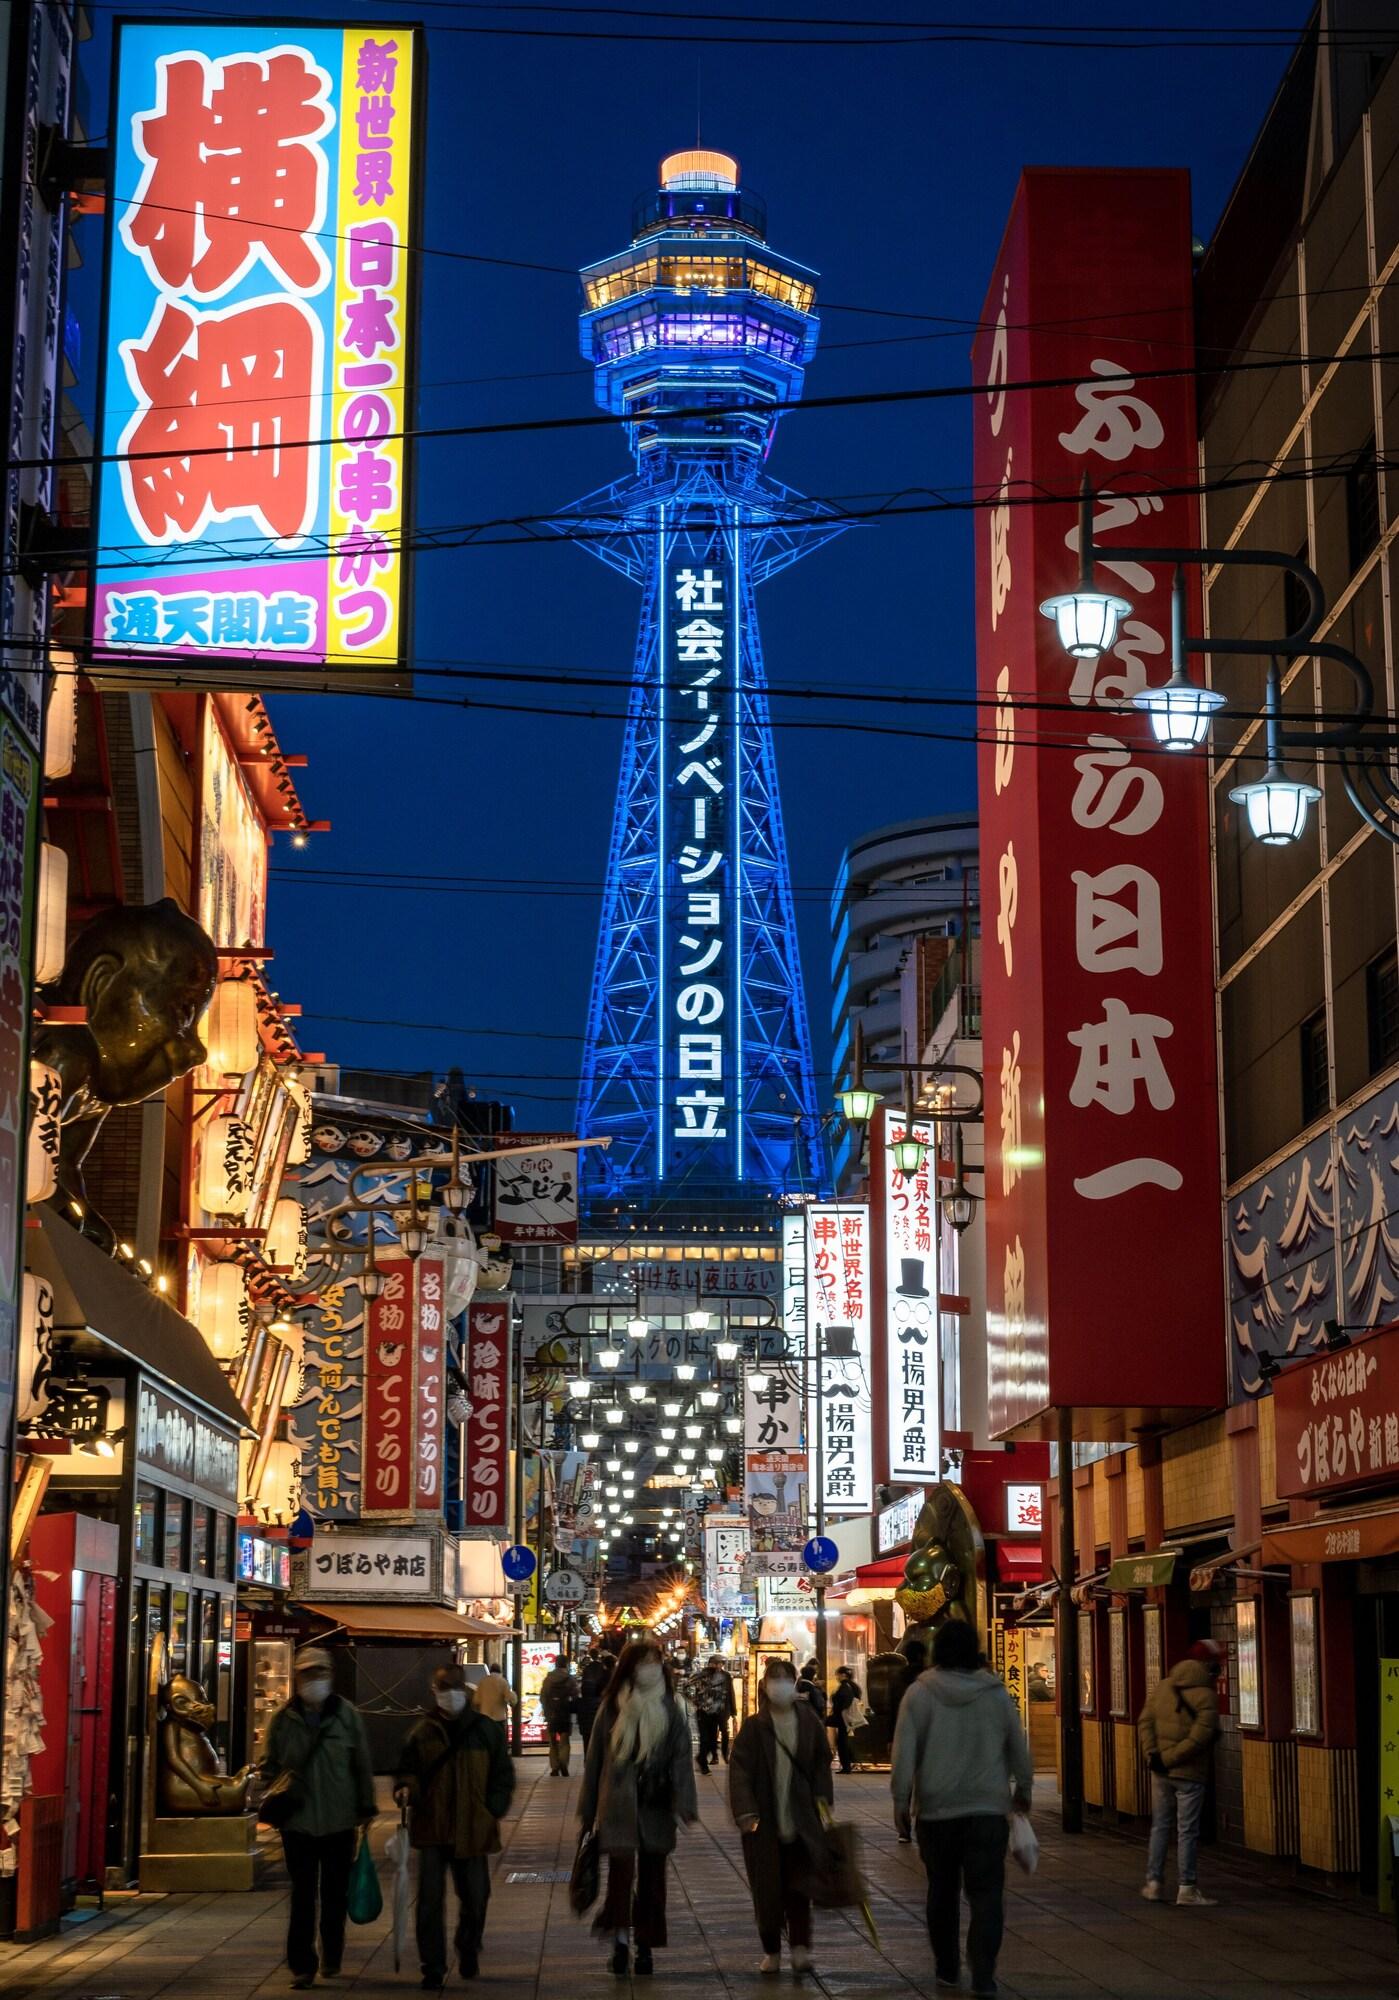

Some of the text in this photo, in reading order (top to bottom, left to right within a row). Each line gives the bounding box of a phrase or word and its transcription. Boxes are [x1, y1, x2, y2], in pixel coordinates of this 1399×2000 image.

[119, 46, 332, 547] 横綱
[338, 38, 398, 650] 新世界 日本一の串かつ
[106, 588, 319, 651] 通天閣店
[675, 568, 727, 1138] 社会イノベーションの日立
[498, 1173, 575, 1206] エビス
[813, 1216, 838, 1289] 串かつ
[842, 1217, 864, 1320] 新世界名物
[316, 1284, 346, 1510] 安うて何んでも旨い
[375, 1272, 406, 1497] 名物 てっちり
[418, 1272, 442, 1496] 名物 てっちり
[472, 1340, 501, 1519] 珍味てっちり
[902, 1349, 926, 1463] 揚男爵
[1311, 1348, 1378, 1407] ふぐなら日本一
[825, 1402, 857, 1498] 揚男爵
[1297, 1406, 1399, 1485] づぼらや新館
[316, 1552, 426, 1577] づぼらや本店
